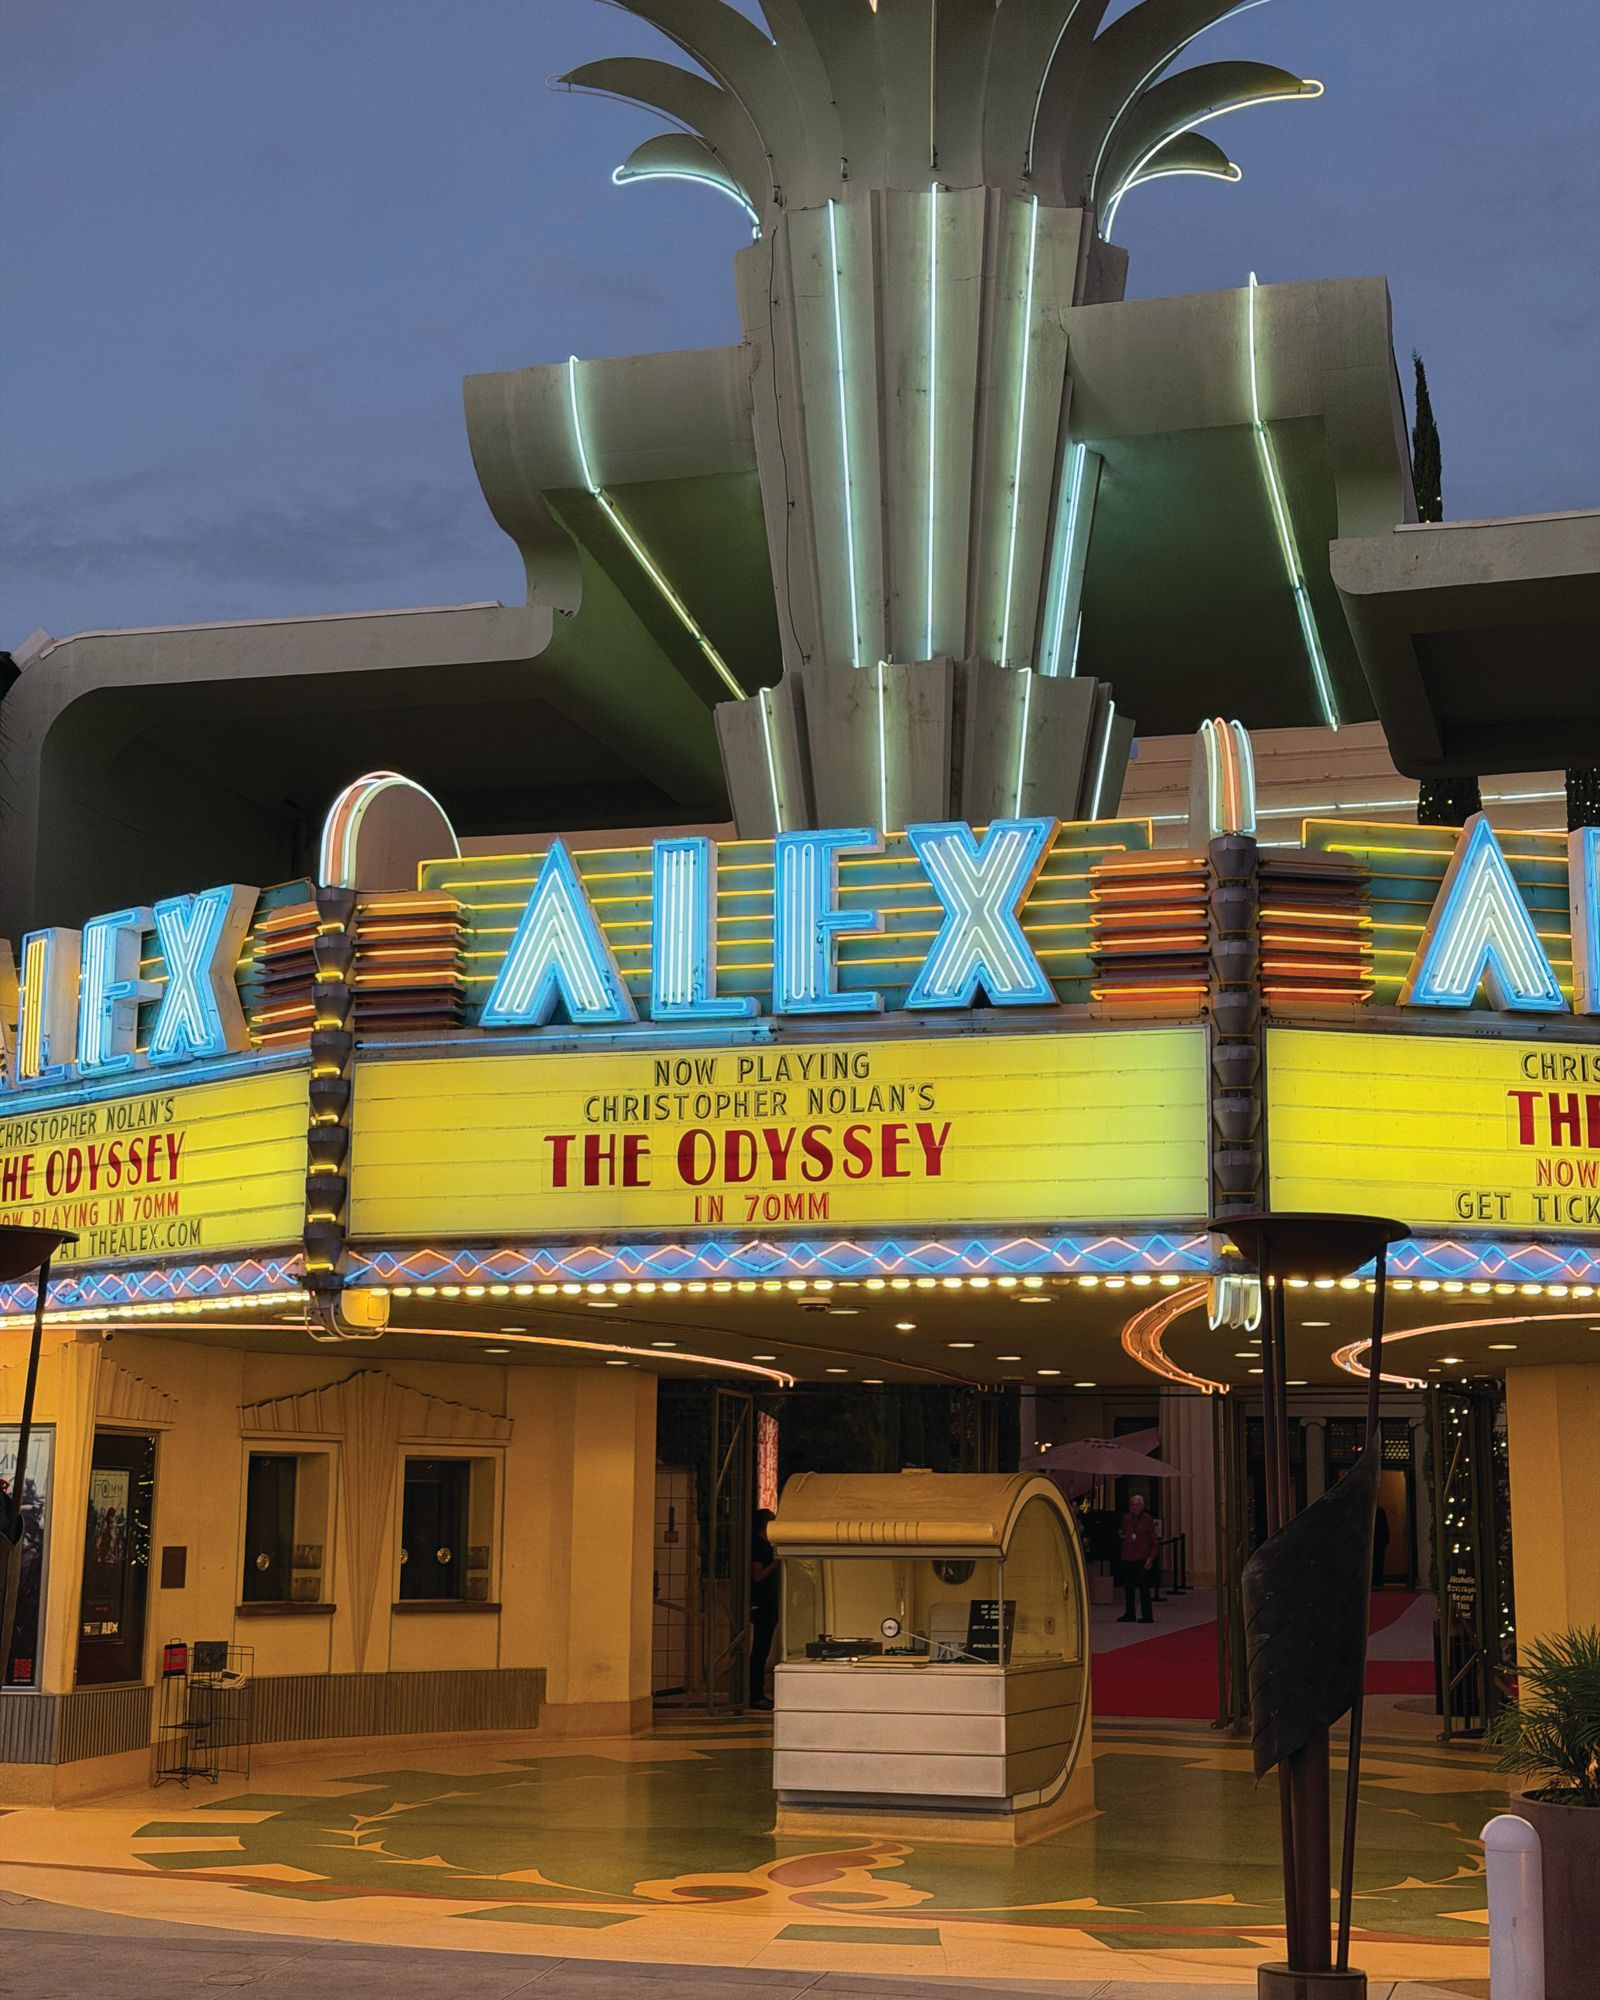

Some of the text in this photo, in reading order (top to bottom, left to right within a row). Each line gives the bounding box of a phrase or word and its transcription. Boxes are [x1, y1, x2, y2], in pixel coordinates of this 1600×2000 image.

[479, 817, 1062, 1027] ALEX
[0, 884, 258, 1090] LEX
[654, 1051, 870, 1087] NOW PLAYING
[105, 1096, 176, 1132] NOLAN'S
[583, 1082, 936, 1123] CHRISTOPHER NOLAN'S
[0, 1131, 186, 1203] HE ODYSSEY
[543, 1121, 953, 1188] THE ODYSSEY
[1536, 1158, 1599, 1189] NOW
[108, 1198, 125, 1225] IN
[133, 1190, 180, 1221] 70MM
[694, 1191, 830, 1223] IN 70MM
[1456, 1190, 1512, 1221] GET
[89, 1218, 201, 1257] THEALEX.COM
